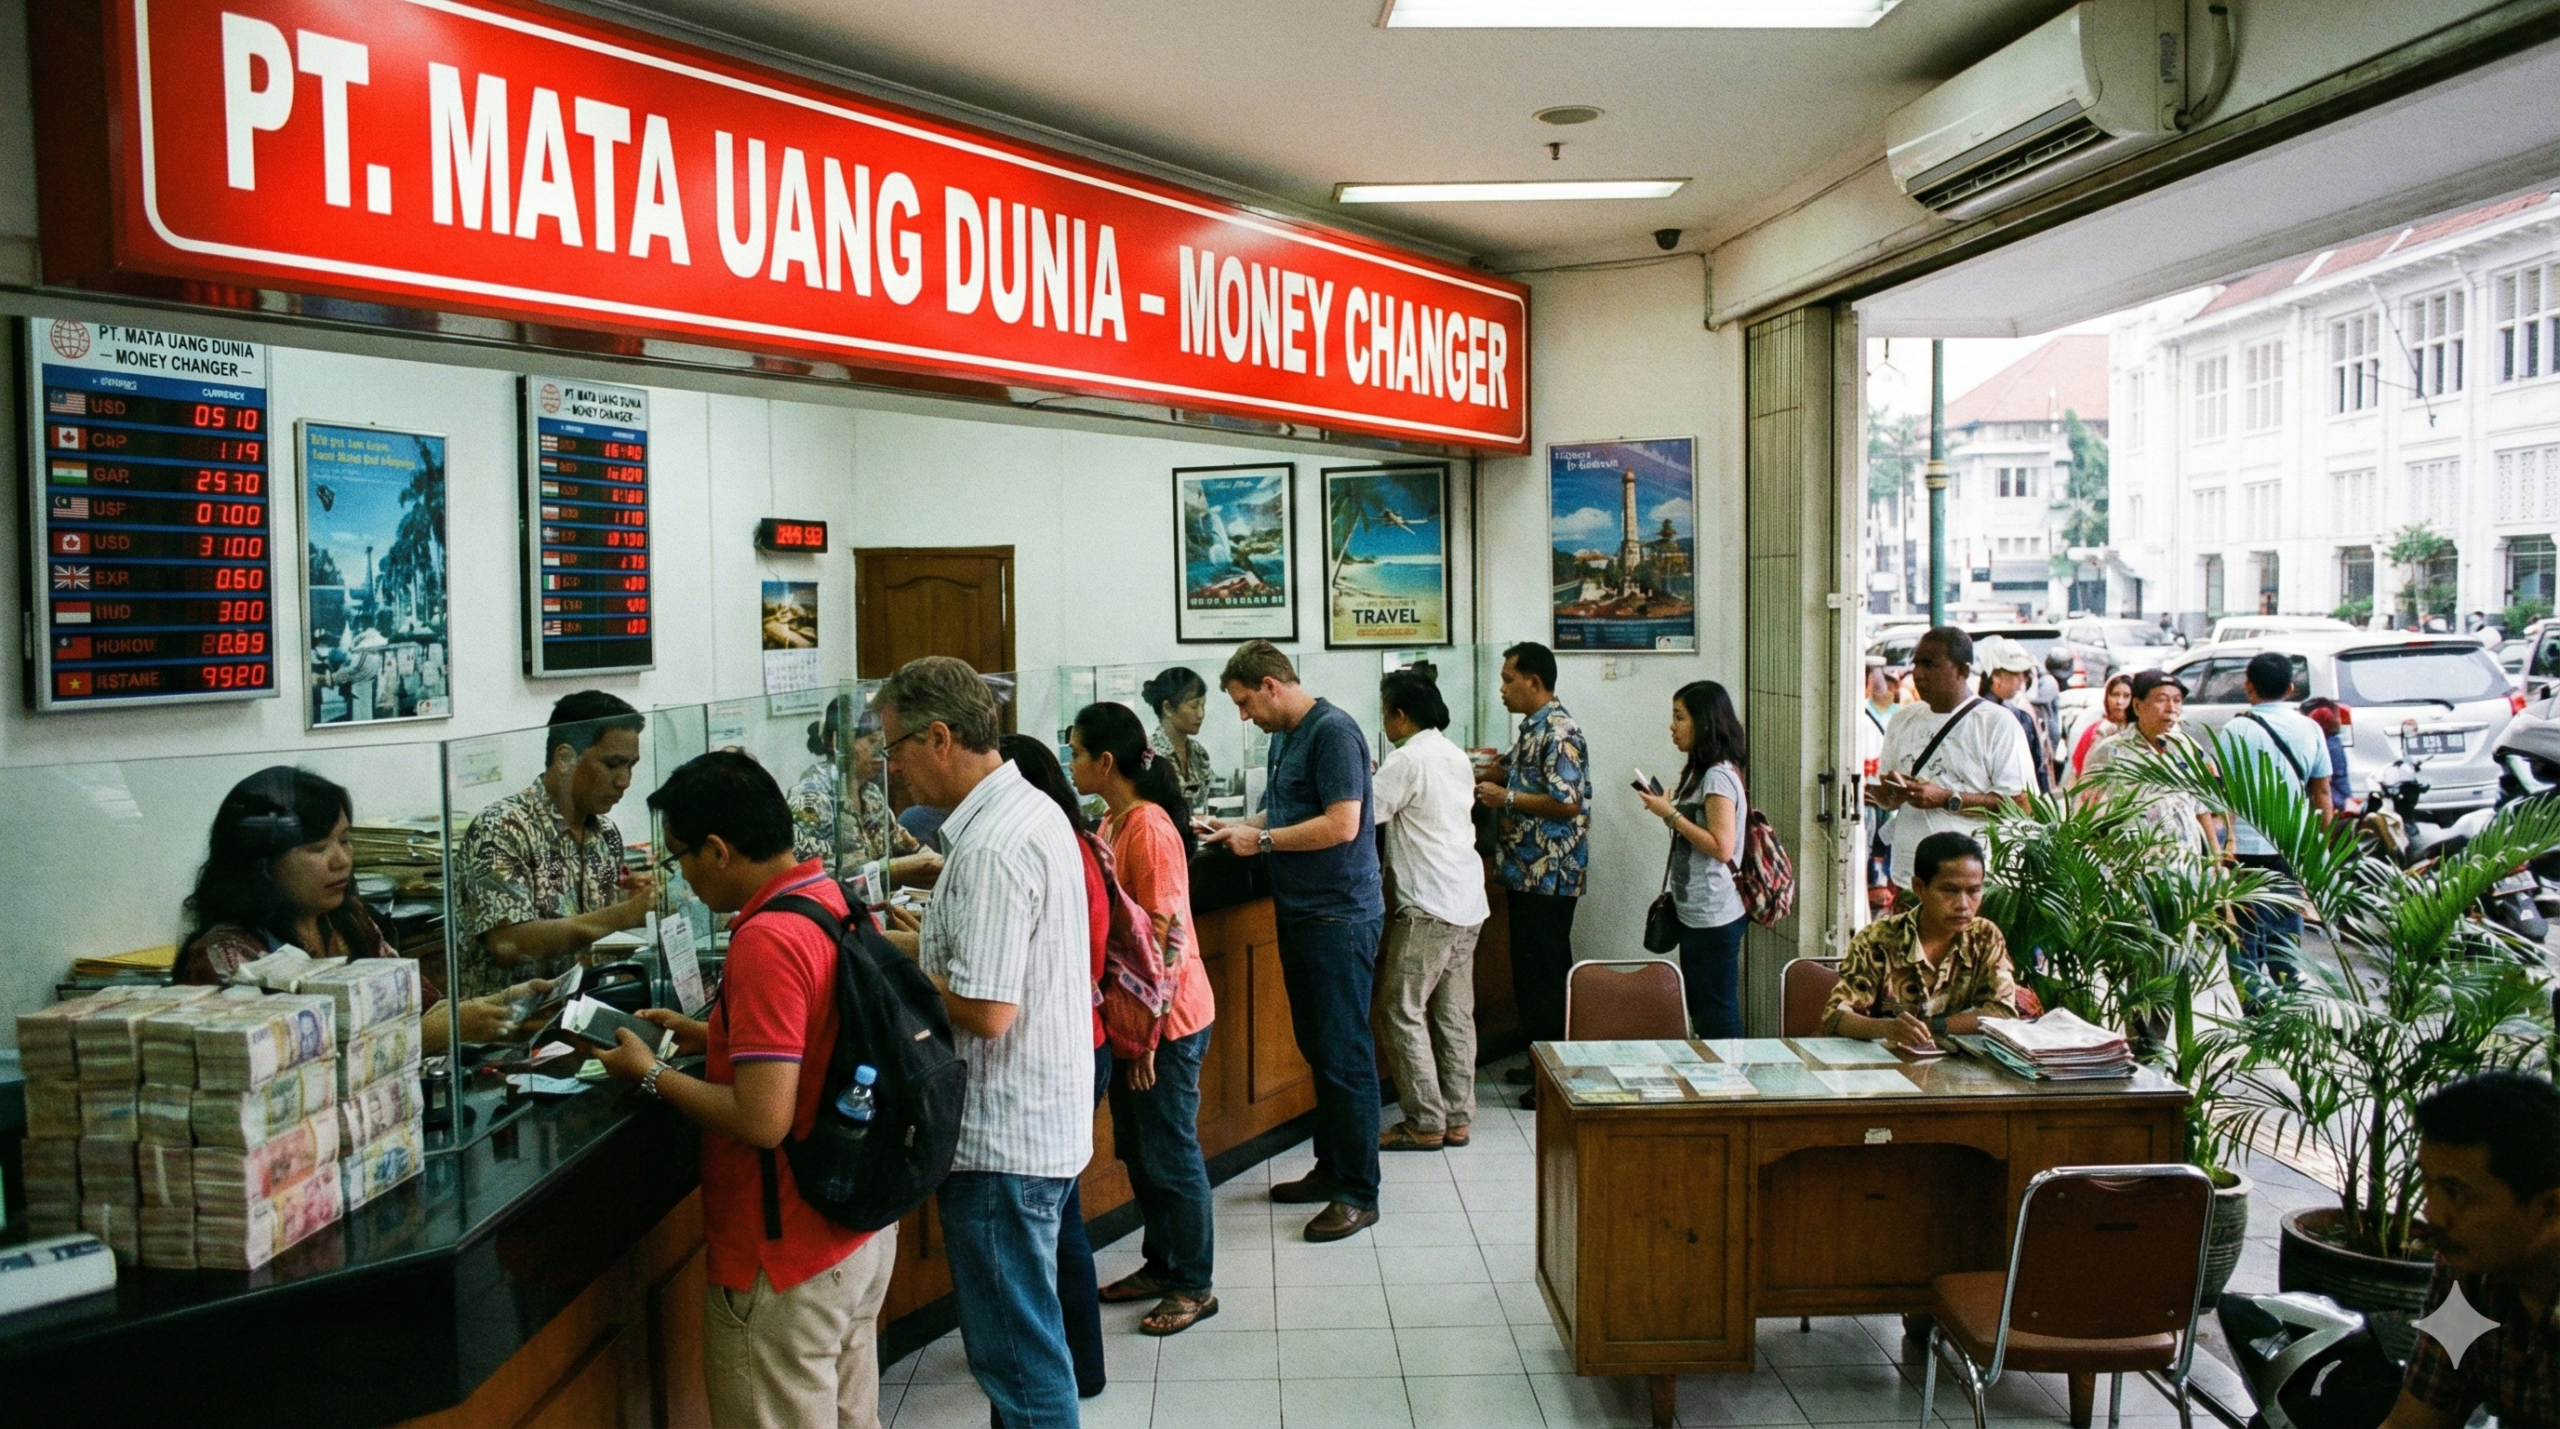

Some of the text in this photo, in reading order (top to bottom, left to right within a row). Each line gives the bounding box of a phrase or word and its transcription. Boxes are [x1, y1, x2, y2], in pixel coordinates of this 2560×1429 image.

[222, 11, 392, 215] PT.
[428, 61, 691, 266] MATA
[715, 129, 923, 305] UANG
[945, 185, 1127, 342] DUNIA
[1179, 244, 1334, 377] MONEY
[1344, 285, 1509, 410] CHANGER
[99, 325, 254, 359] PT. MATA UANG DUNIA
[116, 349, 167, 370] MONEY
[171, 356, 239, 378] CHANGER
[91, 400, 127, 415] USD
[94, 534, 131, 550] USD
[1351, 608, 1421, 625] TRAVEL
